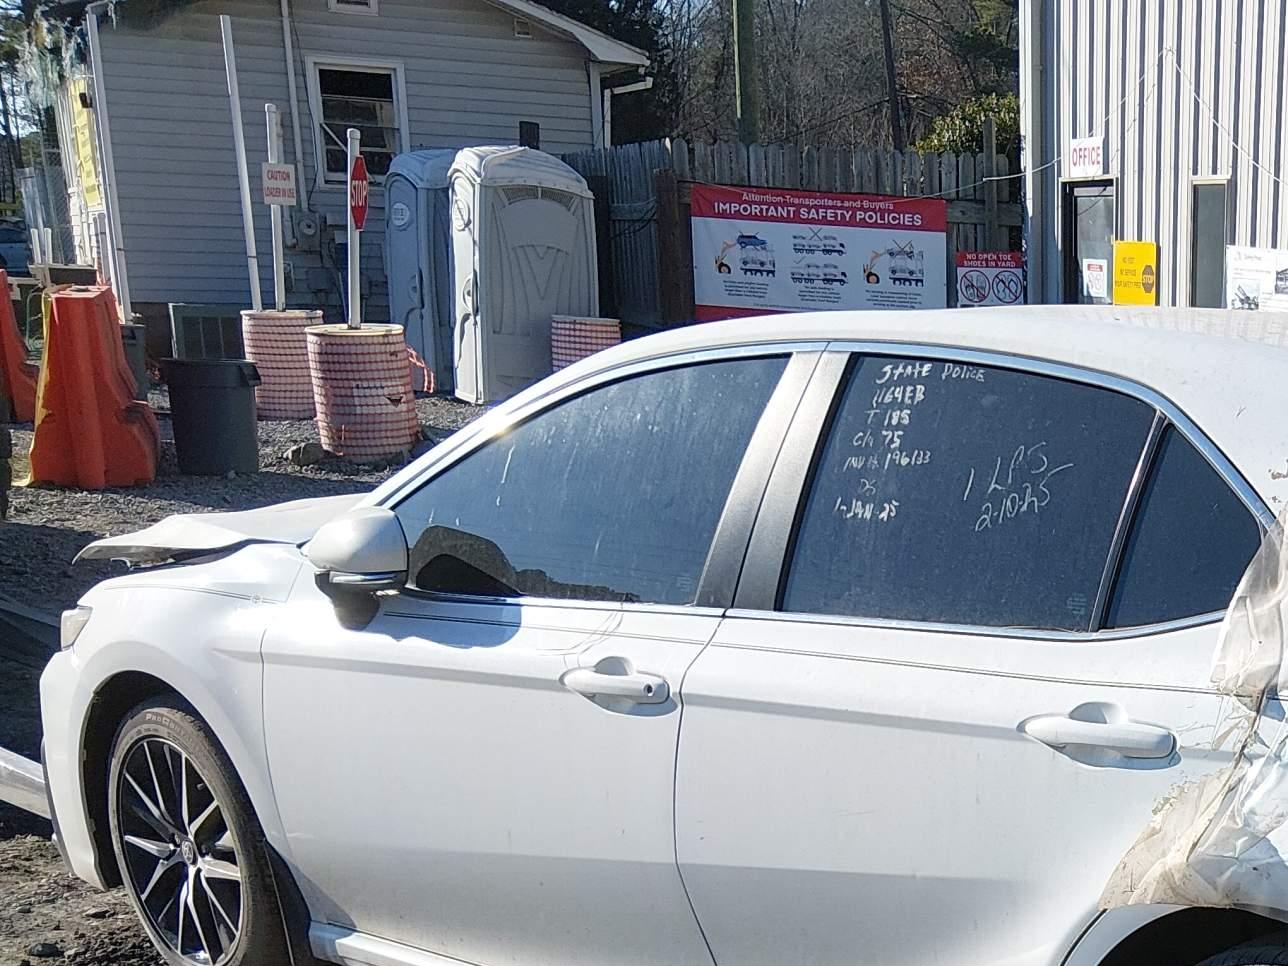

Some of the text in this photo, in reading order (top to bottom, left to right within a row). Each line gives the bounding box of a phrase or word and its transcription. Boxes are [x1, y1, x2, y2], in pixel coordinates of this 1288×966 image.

[1072, 147, 1100, 167] OFFICE
[267, 170, 290, 181] CAUTION
[351, 180, 367, 207] STOP
[742, 192, 894, 210] Attention Transporters and Buyers
[714, 202, 922, 226] IMPORTANT SAFETY POLICIES
[978, 253, 997, 261] OPEN
[864, 409, 881, 425] T
[881, 430, 904, 449] 75
